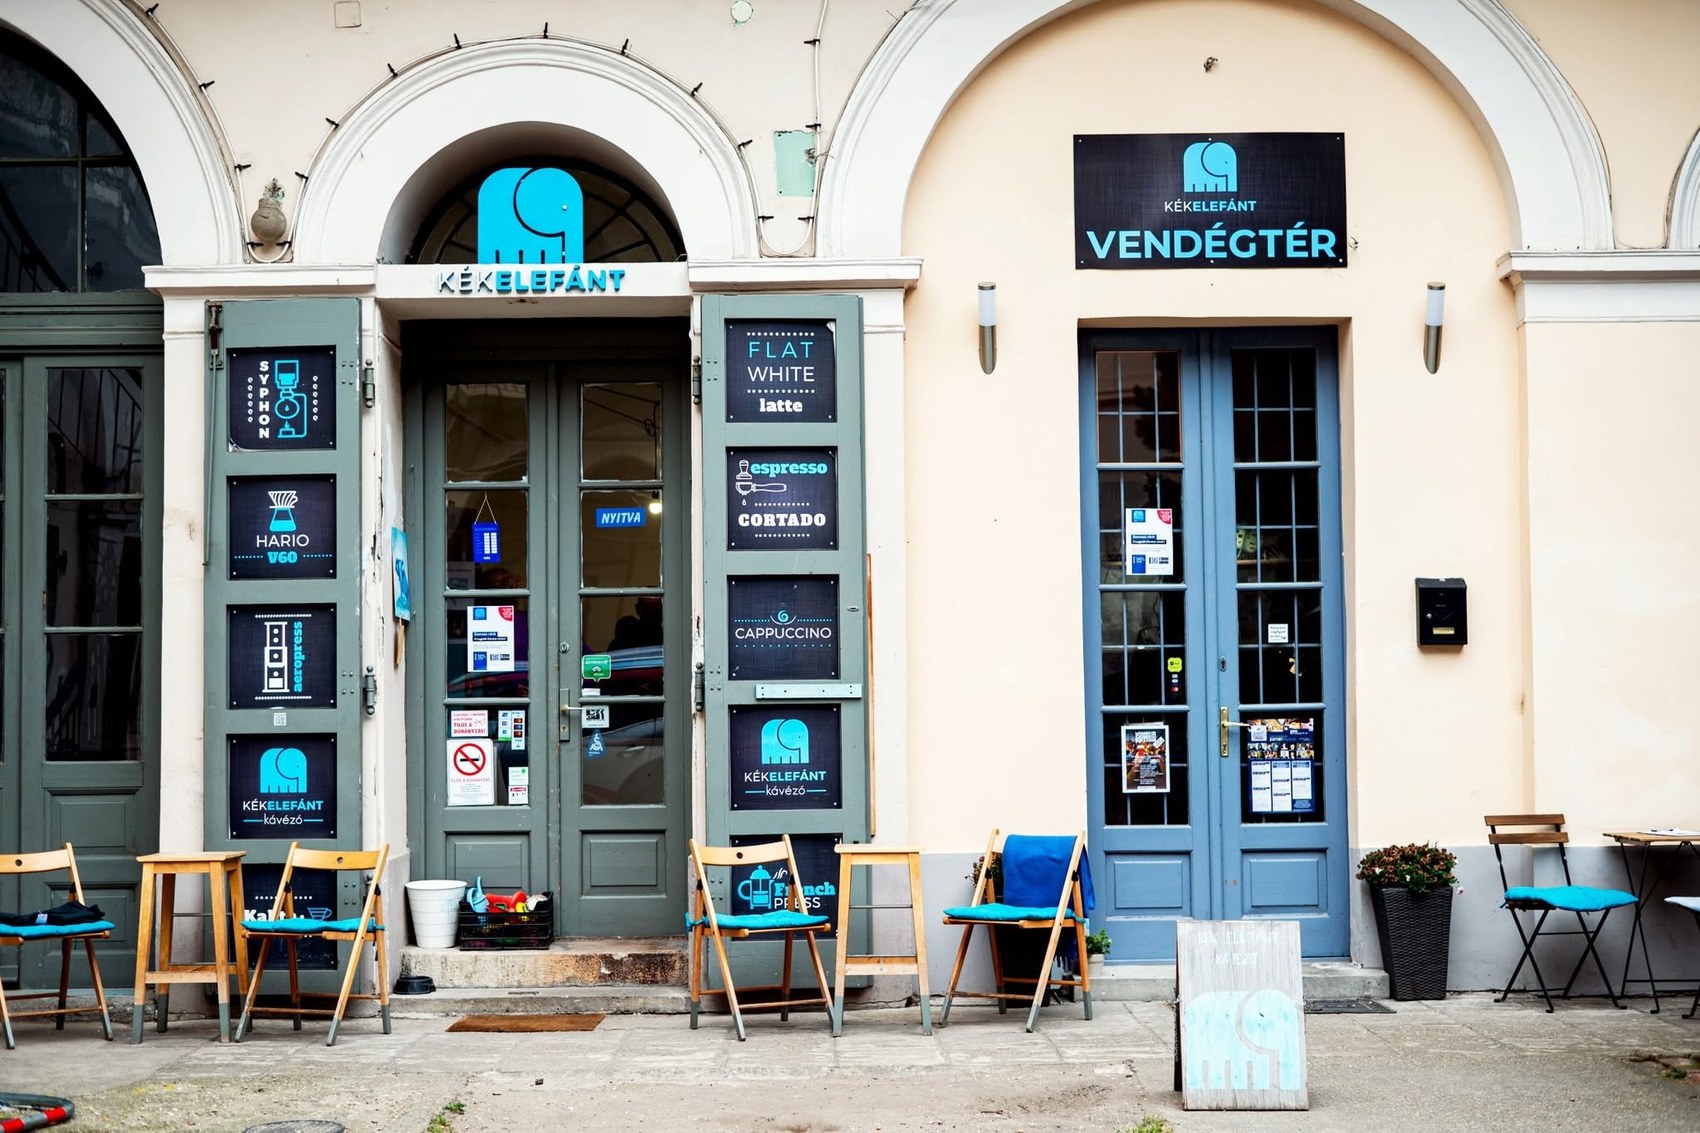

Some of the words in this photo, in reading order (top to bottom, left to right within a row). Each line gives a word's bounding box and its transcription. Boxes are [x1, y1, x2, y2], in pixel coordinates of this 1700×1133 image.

[1164, 198, 1257, 212] KÉKELEFÁNT
[1086, 221, 1337, 259] VENDÉGTÉR
[438, 265, 626, 294] KÉKELEFÁNT
[749, 341, 814, 358] FLAT
[747, 366, 815, 382] WHITE
[258, 360, 270, 439] SYPHON
[759, 398, 803, 412] latte
[750, 462, 828, 477] espresso
[601, 511, 641, 525] NYITVA
[738, 513, 826, 527] CORTADO
[256, 534, 310, 547] HARIO
[267, 551, 298, 564] V60
[735, 627, 832, 640] CAPPUCCINO
[294, 621, 305, 693] aeropress
[744, 769, 827, 782] KÉKELEFÁNT
[765, 784, 806, 796] kávézó
[243, 798, 324, 811] KÉKELEFÁNT
[263, 812, 303, 825] kávézó
[774, 881, 836, 896] Frnch
[244, 909, 298, 922] Kalt
